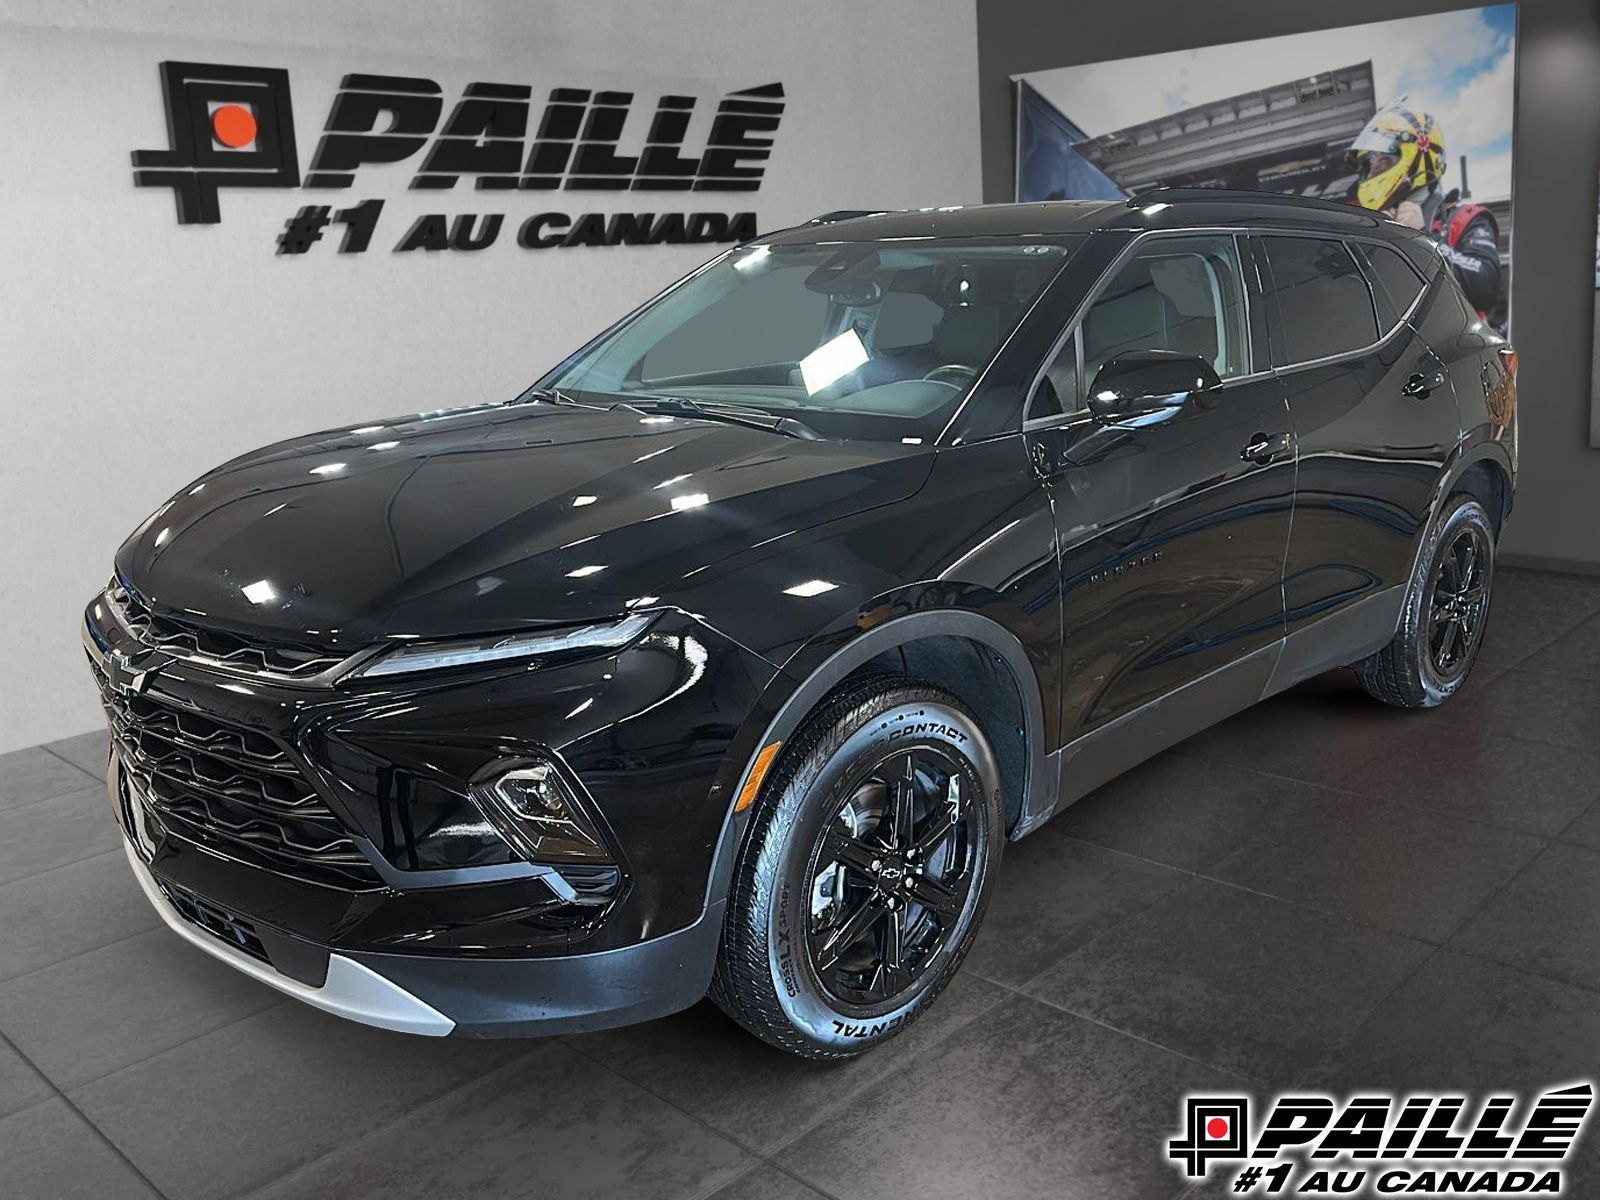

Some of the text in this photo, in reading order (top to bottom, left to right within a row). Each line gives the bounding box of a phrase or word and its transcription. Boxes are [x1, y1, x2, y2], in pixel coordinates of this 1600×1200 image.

[302, 74, 785, 191] PAILLÉ
[275, 199, 758, 255] #1 AU CANADA
[889, 722, 968, 743] CONTACT
